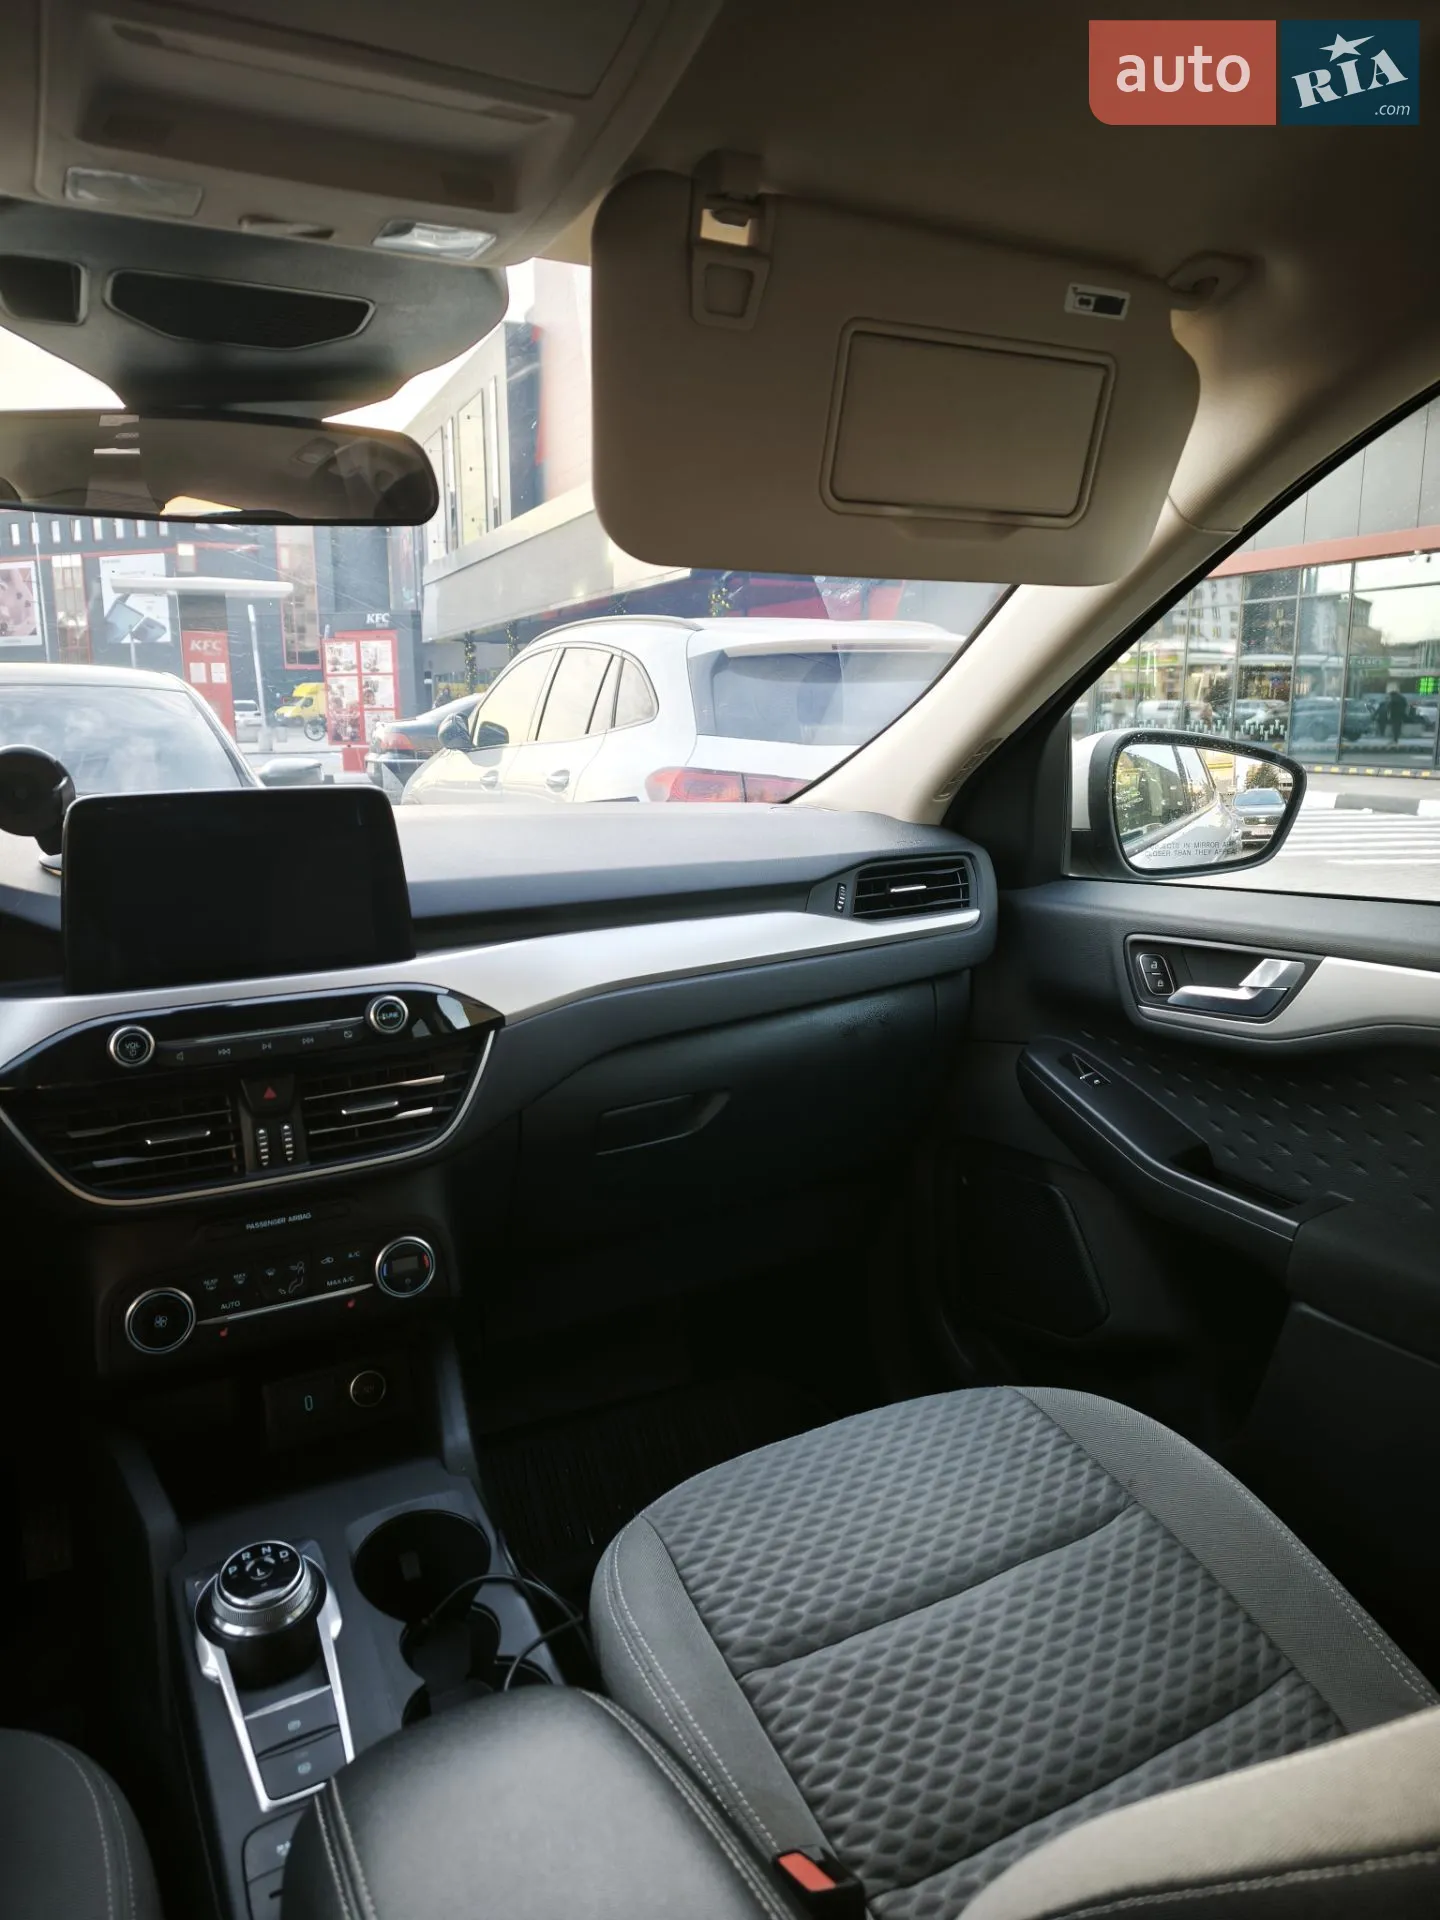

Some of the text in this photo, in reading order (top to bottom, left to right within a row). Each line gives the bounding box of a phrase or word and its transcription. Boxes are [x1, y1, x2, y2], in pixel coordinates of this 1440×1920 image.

[366, 612, 391, 625] KFC
[189, 639, 222, 651] KFC
[245, 1212, 312, 1230] PASSENGER AIRBAG
[326, 1275, 355, 1287] MAX A/C
[220, 1300, 241, 1310] AUTO
[228, 1545, 289, 1575] P R N D
[256, 1567, 265, 1576] L
